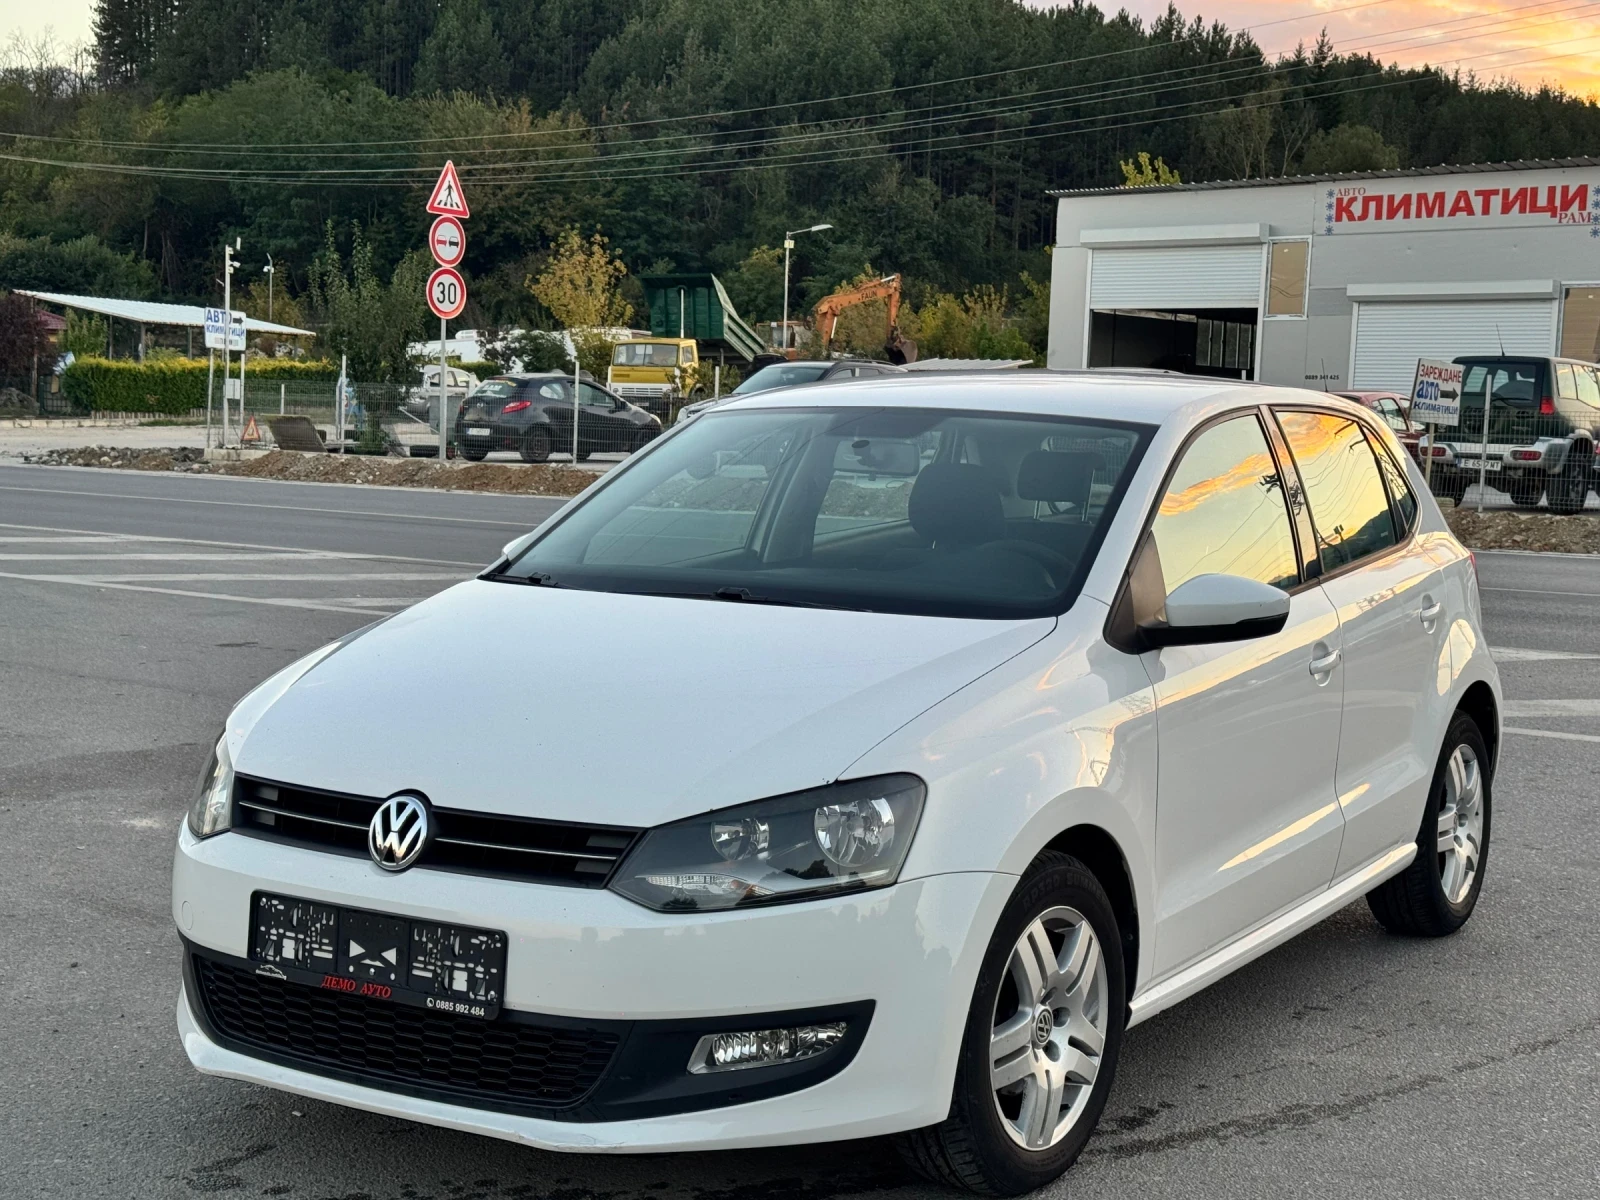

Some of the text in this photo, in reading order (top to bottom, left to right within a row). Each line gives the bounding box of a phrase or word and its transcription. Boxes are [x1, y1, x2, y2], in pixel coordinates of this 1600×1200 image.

[1336, 187, 1366, 197] АВТО
[1335, 184, 1588, 222] КЛИМАТИЦИ
[1558, 211, 1592, 224] РАМ
[437, 282, 456, 304] 30
[206, 324, 245, 337] КЛИМИЦИ
[1420, 364, 1461, 383] ЗАРЕЖДАНЕ
[321, 976, 391, 998] ДЕМО АУТО
[435, 1000, 485, 1017] 0885 992 484
